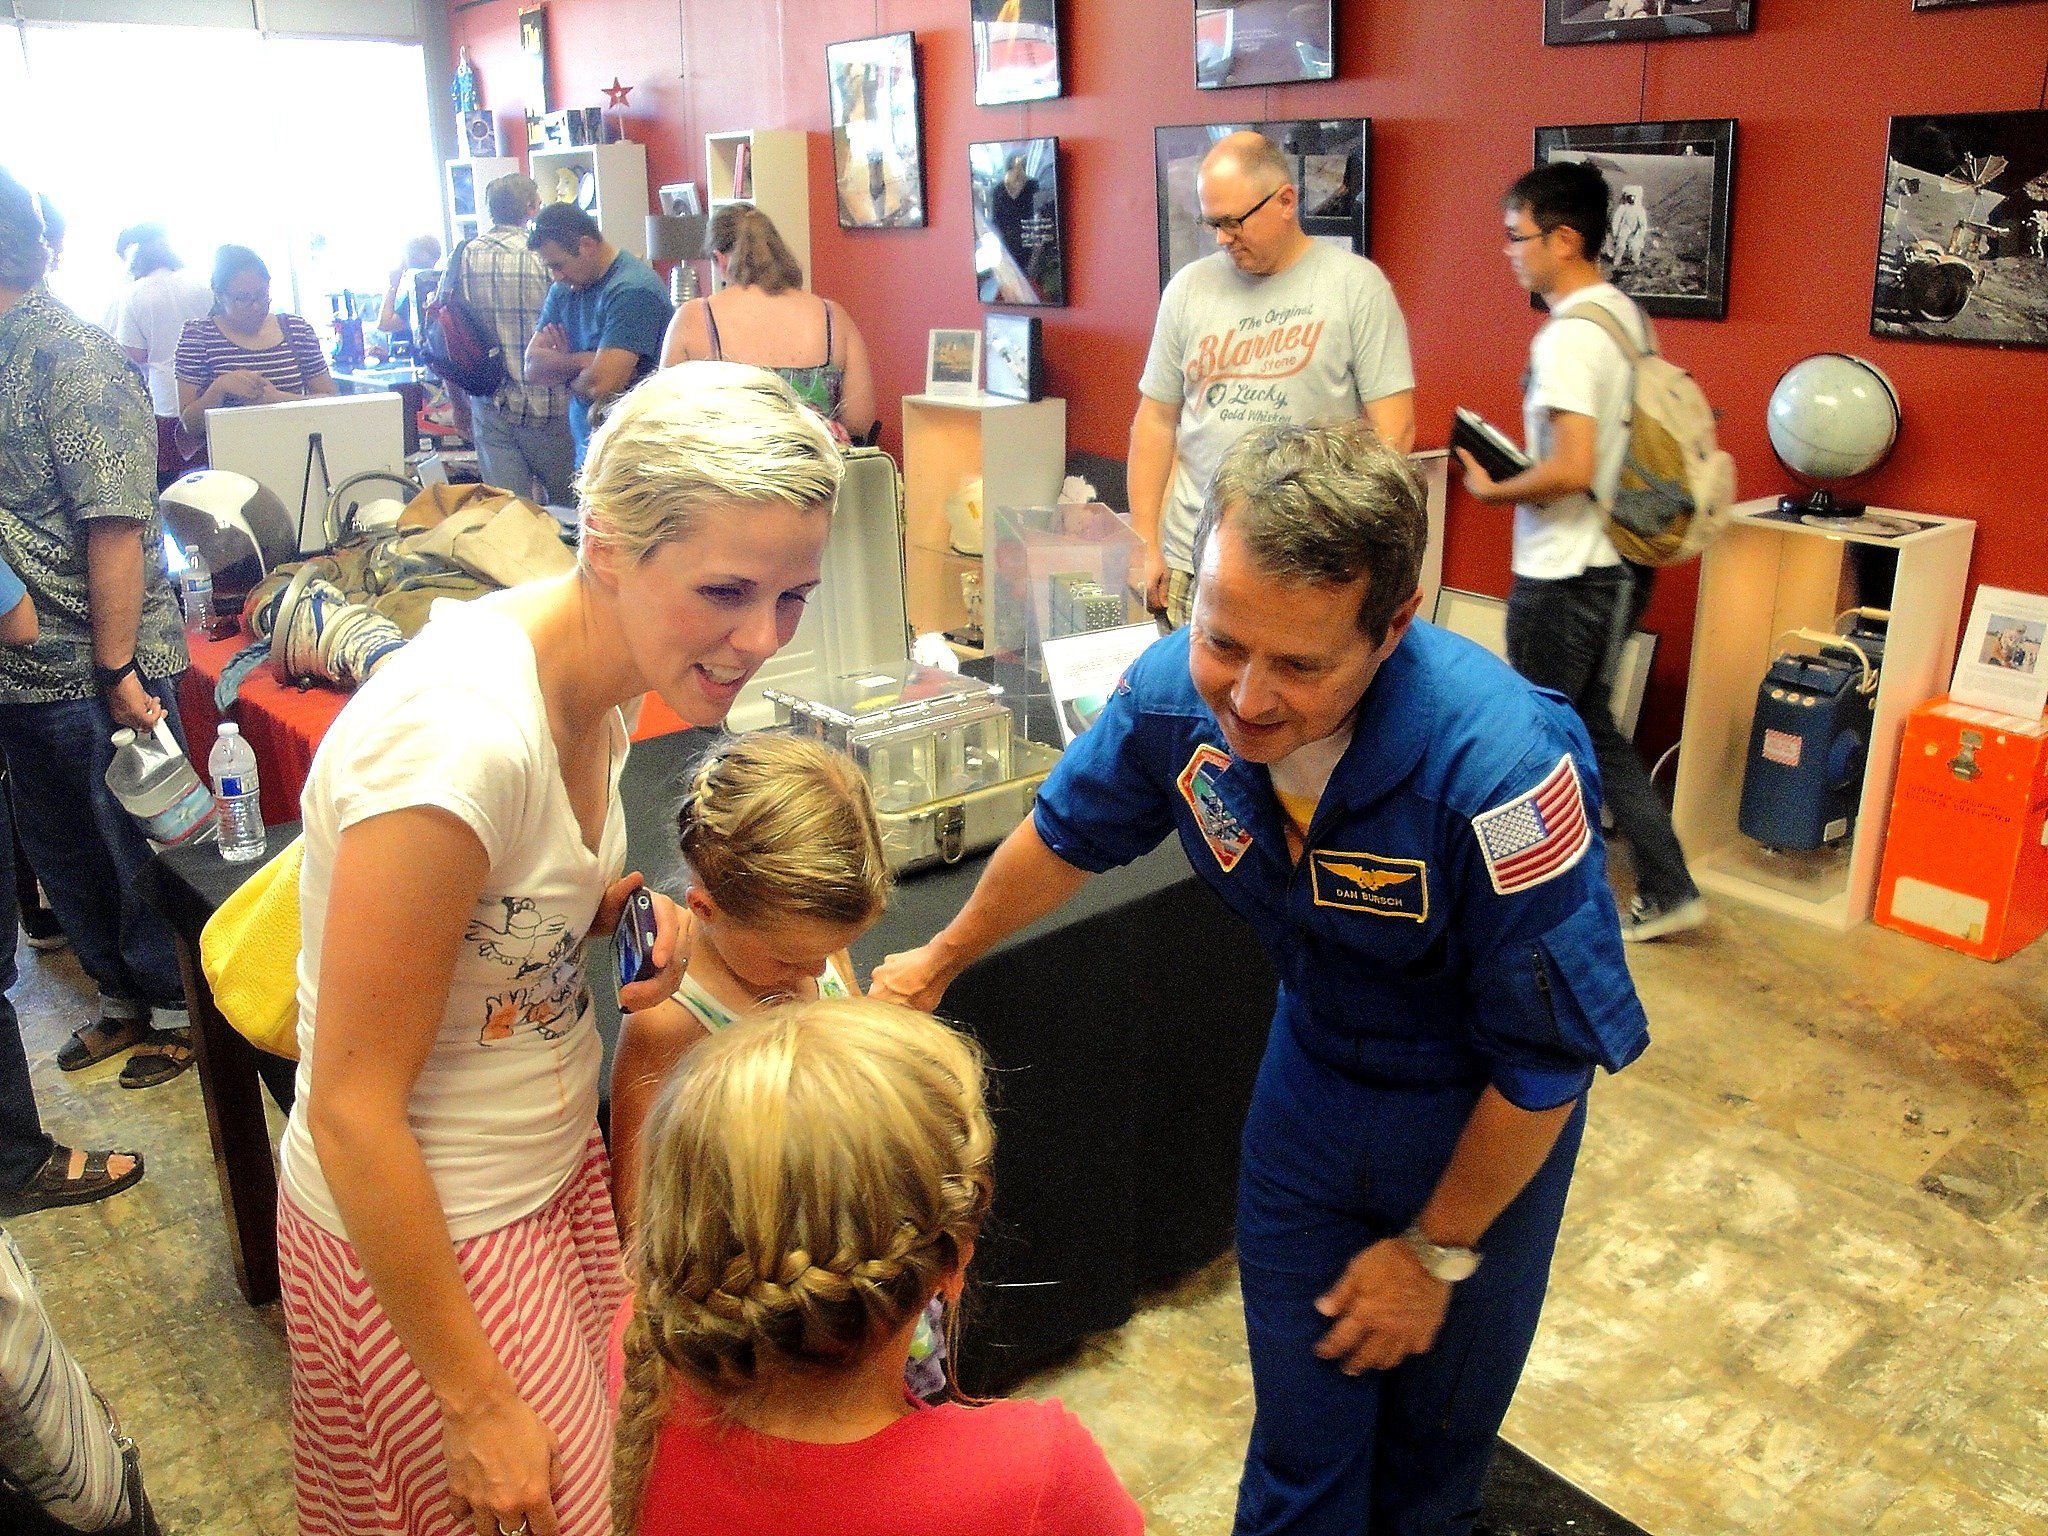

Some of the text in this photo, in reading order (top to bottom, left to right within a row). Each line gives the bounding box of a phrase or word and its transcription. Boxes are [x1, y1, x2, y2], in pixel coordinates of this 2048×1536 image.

[1239, 303, 1314, 332] The Original
[1186, 319, 1325, 384] Blarney
[1228, 383, 1288, 409] Lucky
[1220, 408, 1247, 422] Gold
[1336, 888, 1403, 907] DAN BURSCH
